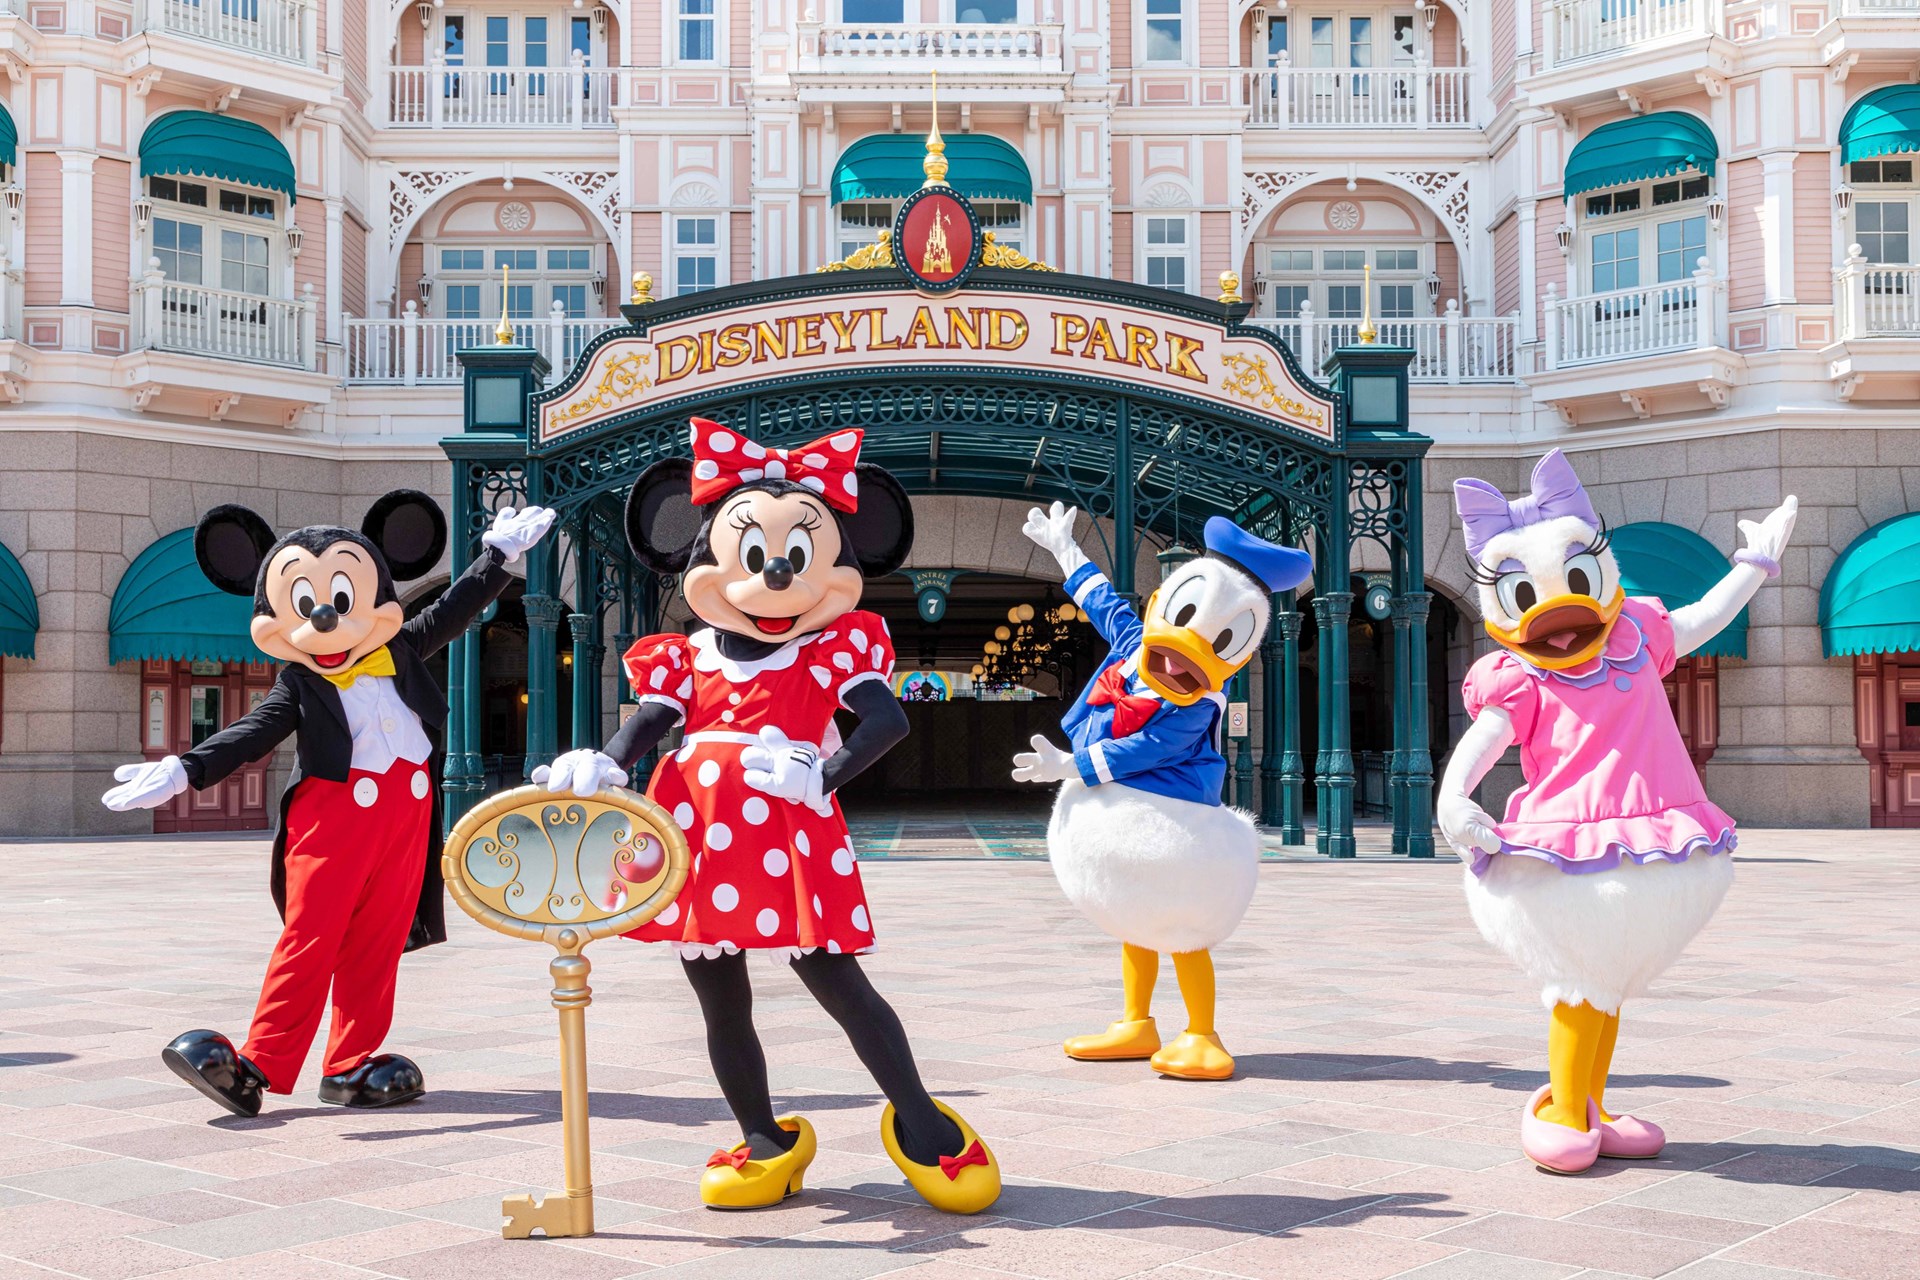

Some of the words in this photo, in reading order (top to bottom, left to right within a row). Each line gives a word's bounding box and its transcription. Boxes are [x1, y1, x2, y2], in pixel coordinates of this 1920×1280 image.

[655, 305, 1029, 386] DISNEYLAND
[1050, 311, 1208, 384] PARK
[927, 598, 939, 614] 7
[1374, 594, 1386, 610] 6
